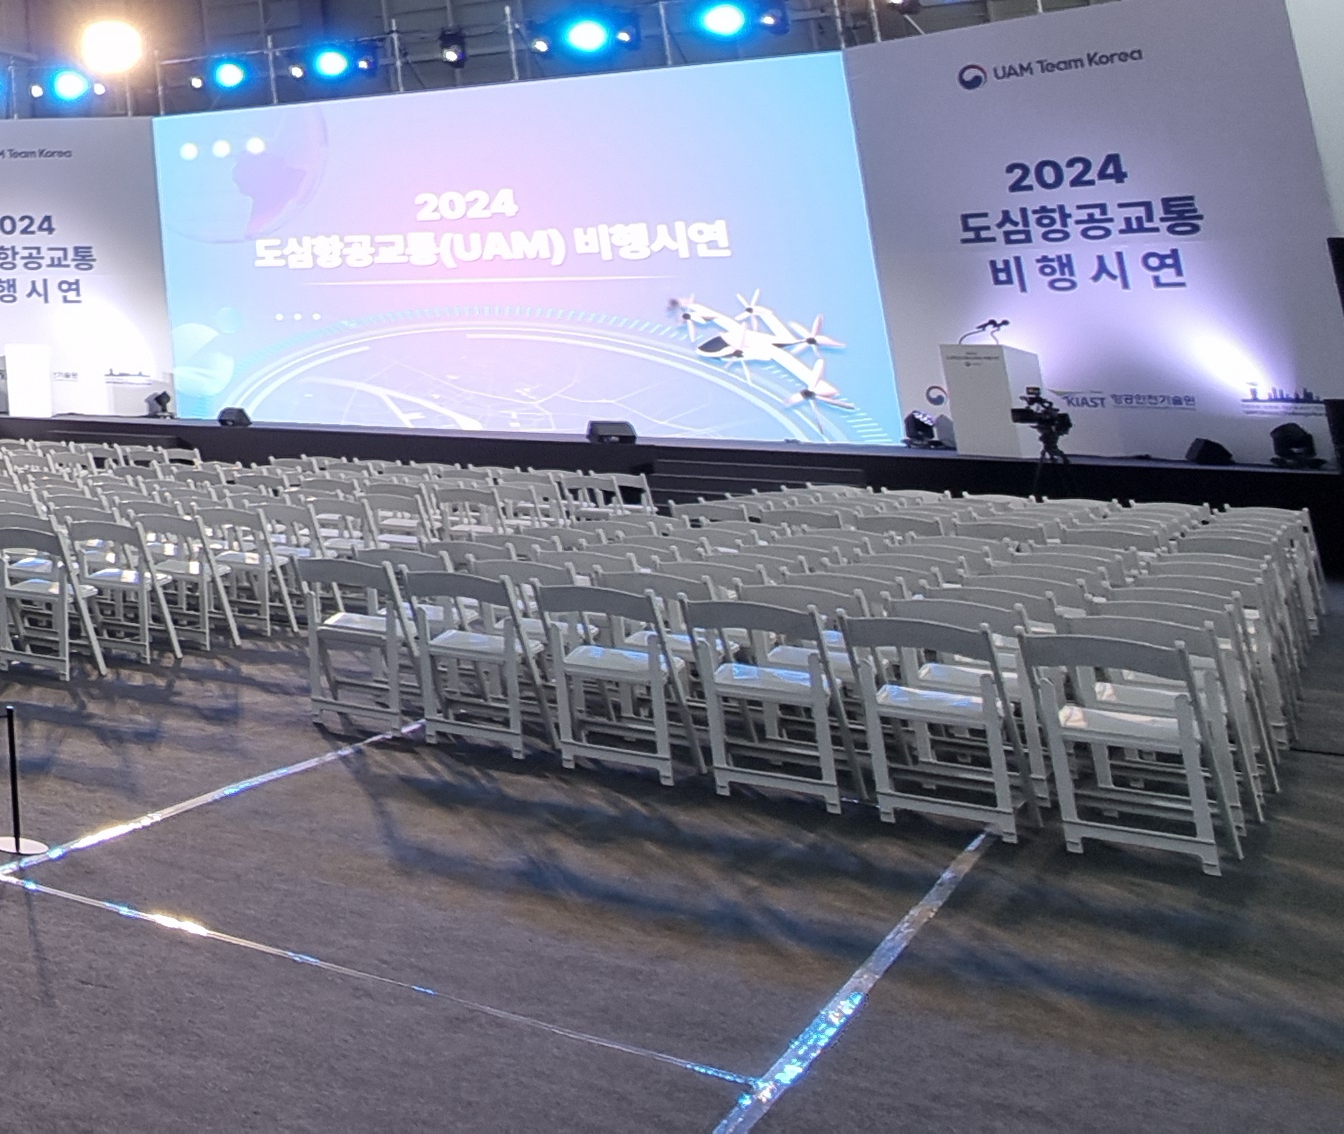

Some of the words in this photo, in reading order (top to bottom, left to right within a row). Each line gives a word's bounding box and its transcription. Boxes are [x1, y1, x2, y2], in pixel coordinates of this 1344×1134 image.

[993, 63, 1034, 81] UAM
[1036, 56, 1085, 75] Team
[1087, 47, 1144, 67] Korea
[7, 148, 37, 159] Team
[38, 147, 73, 159] Korea
[1005, 153, 1129, 194] 2024
[414, 188, 519, 222] 2024
[959, 195, 1205, 245] 도심항공교통
[253, 228, 568, 270] 도심항공교통(UAM)
[573, 220, 733, 261] 비행시연
[1062, 395, 1107, 408] KIAST
